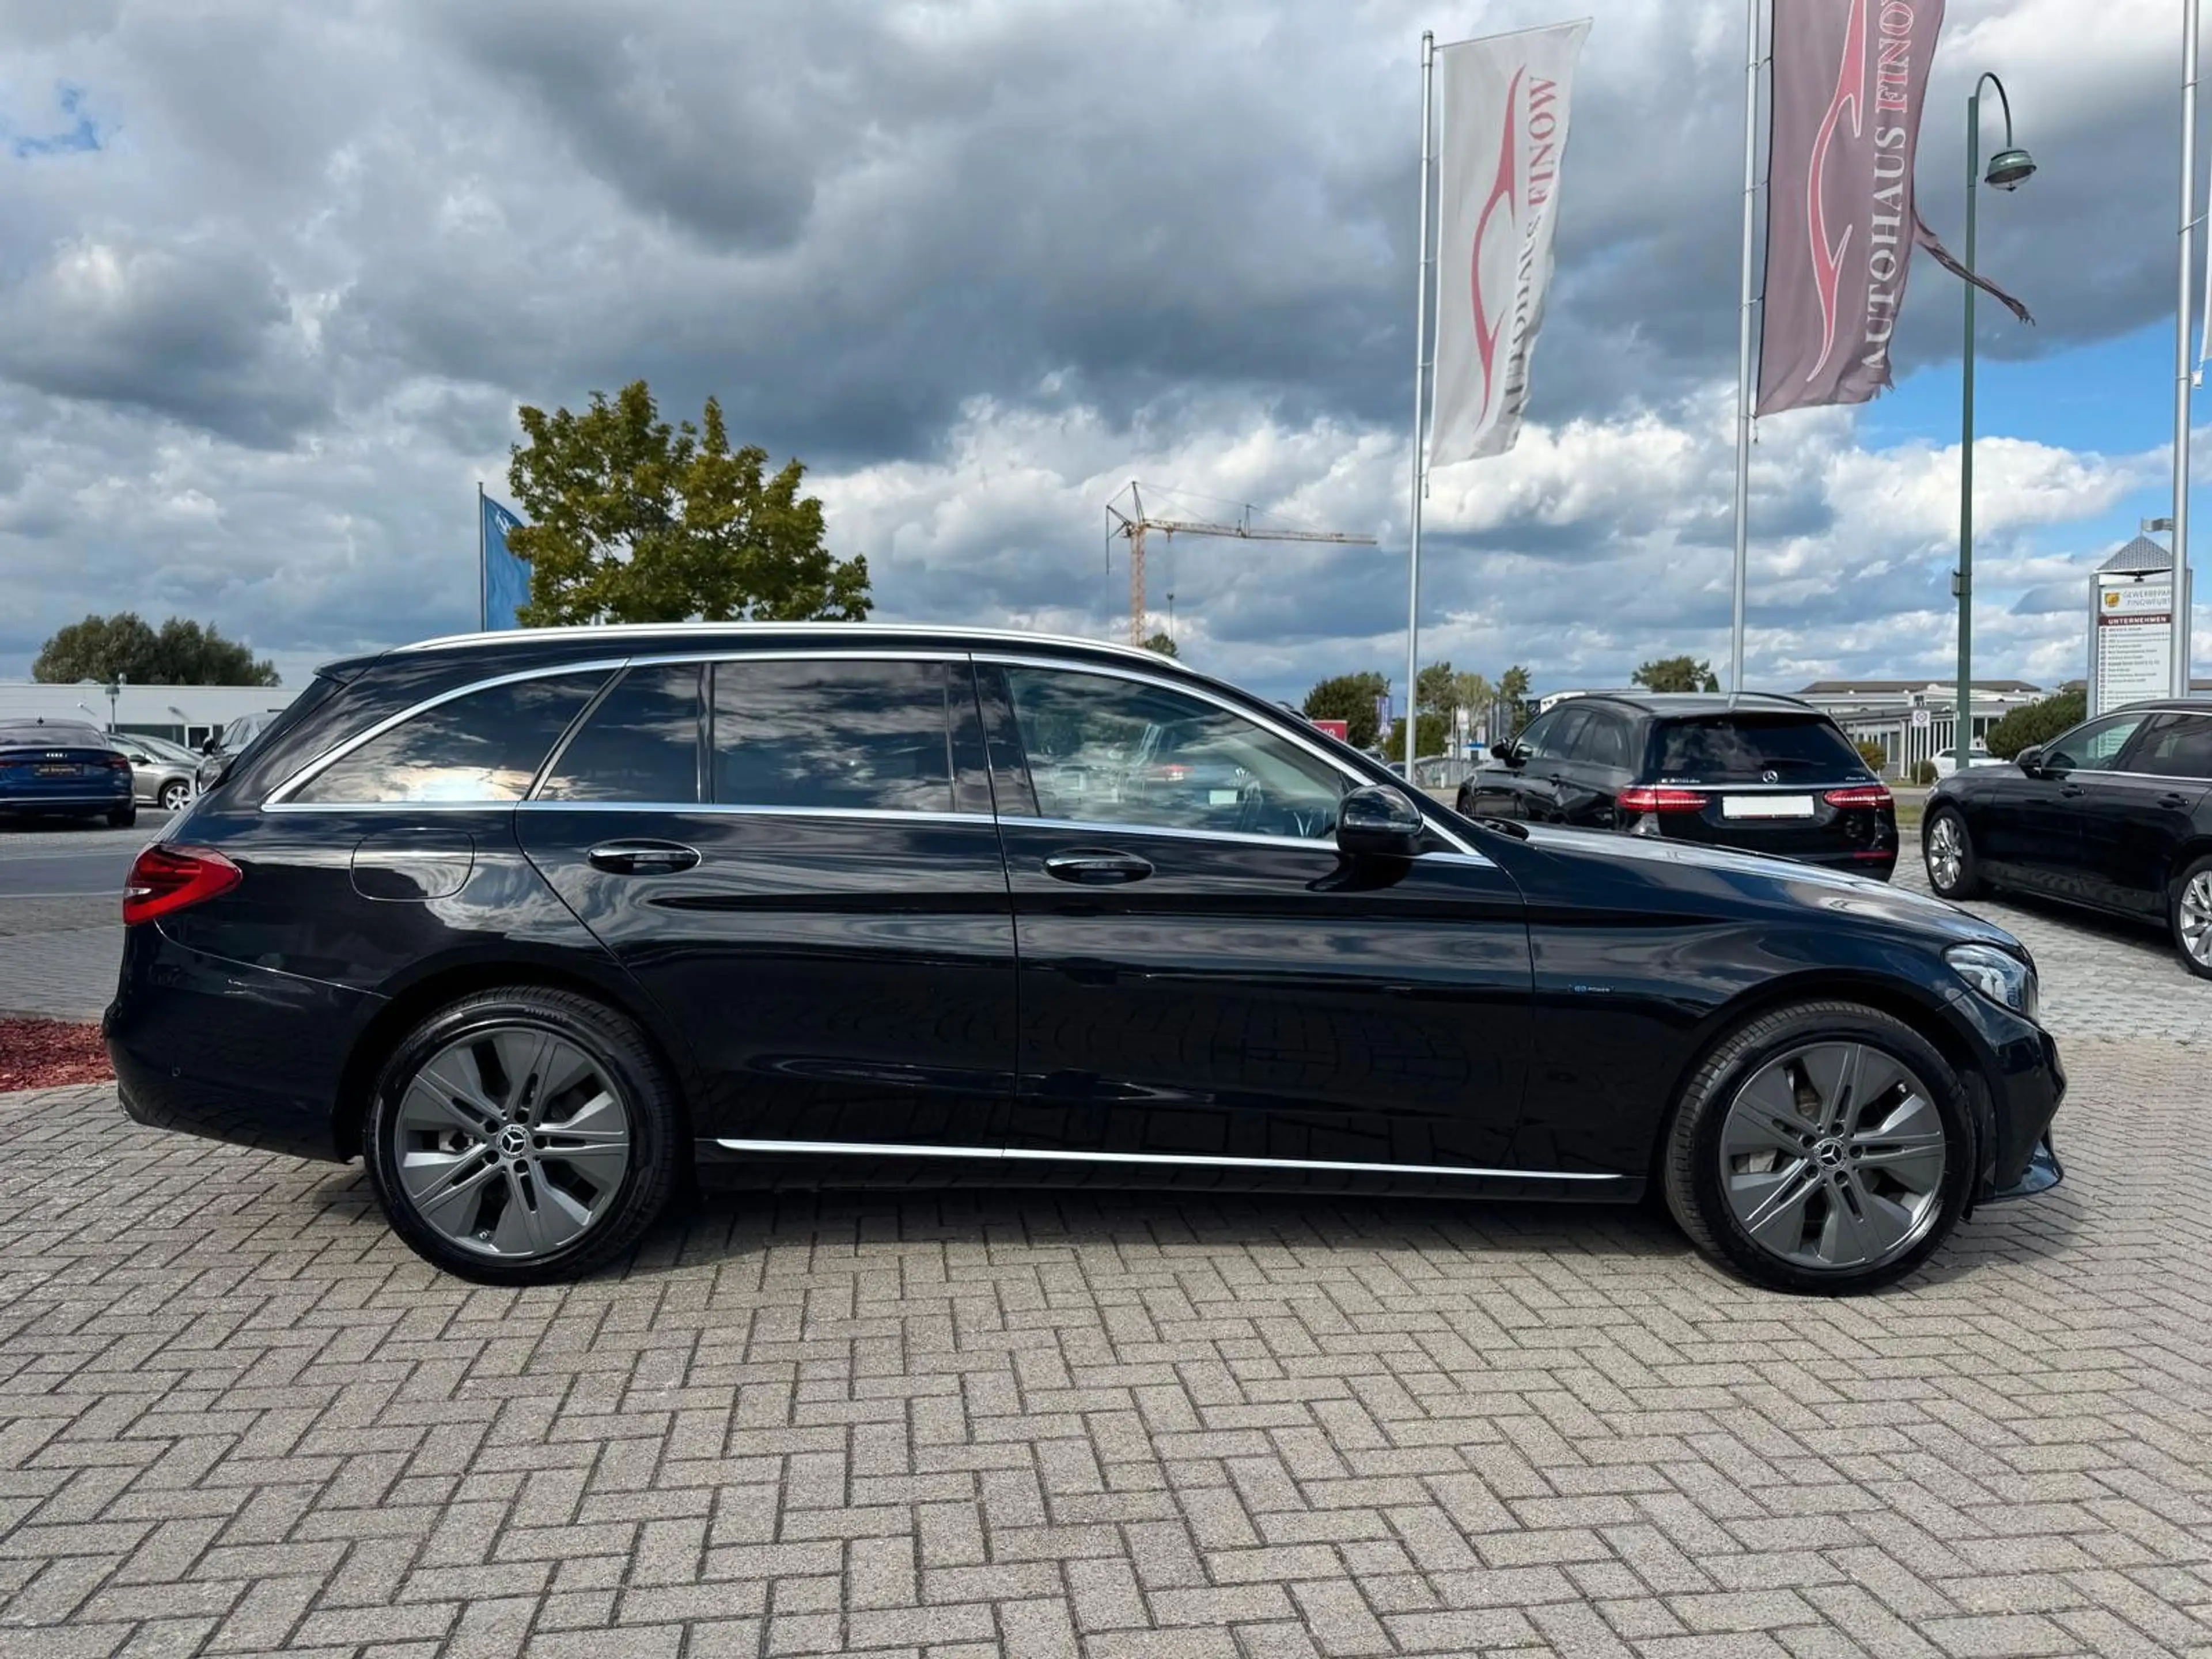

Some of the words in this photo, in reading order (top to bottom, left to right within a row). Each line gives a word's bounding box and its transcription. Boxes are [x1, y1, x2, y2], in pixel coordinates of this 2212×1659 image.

[1874, 0, 1914, 113] FINO
[1528, 75, 1557, 206] FINOW
[1861, 126, 1907, 369] AUTOHAUS
[2108, 616, 2167, 625] UNTERNEHMEN
